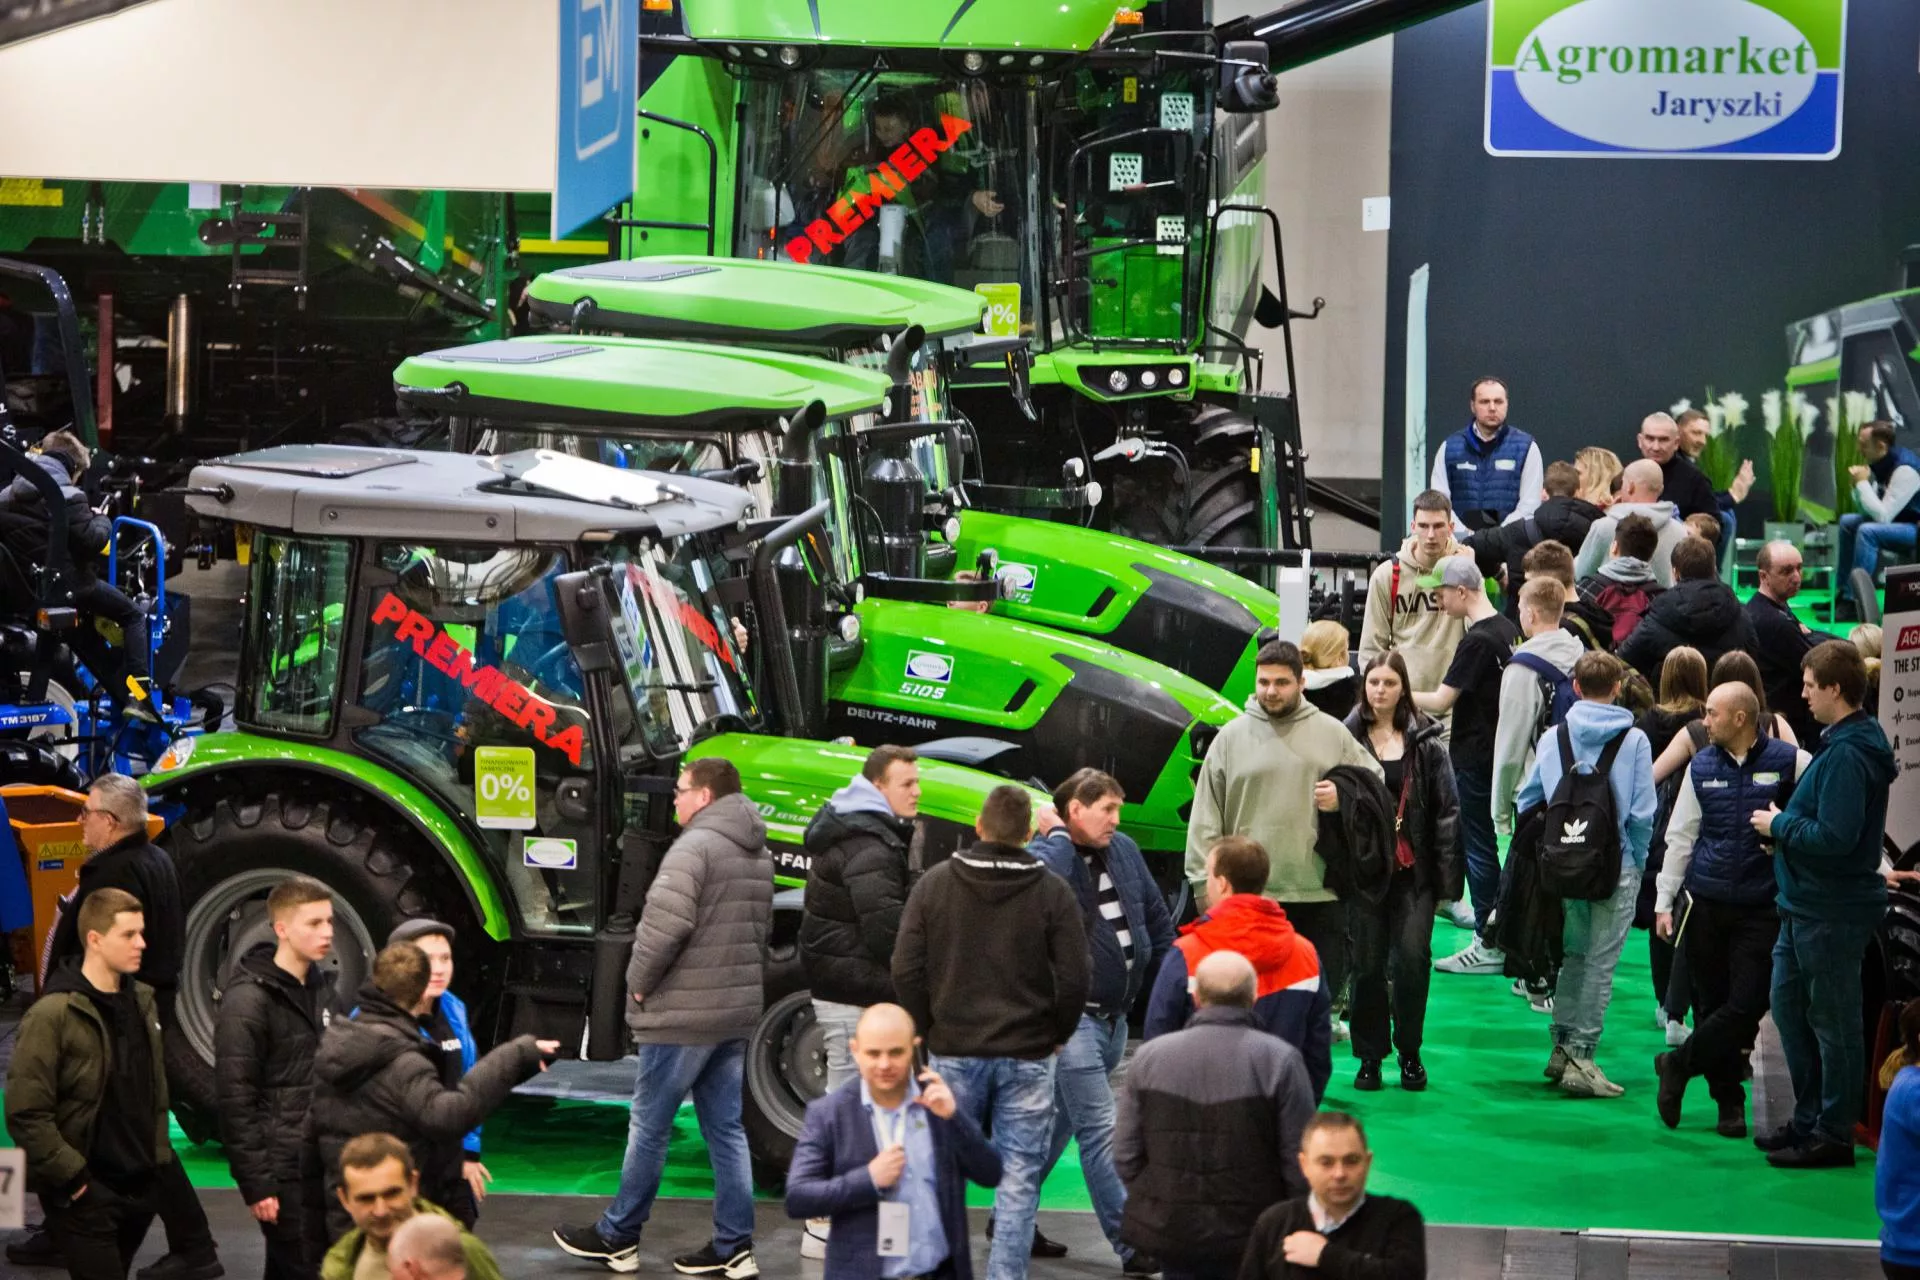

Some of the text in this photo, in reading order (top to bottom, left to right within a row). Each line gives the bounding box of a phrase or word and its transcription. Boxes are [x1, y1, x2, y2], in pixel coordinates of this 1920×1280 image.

[1517, 36, 1813, 84] Agromarket
[1652, 91, 1782, 123] Jaryszki
[784, 112, 972, 264] PREMIERA
[371, 591, 583, 768] PREMIERA
[847, 706, 937, 730] DEUTZ-FAHR
[481, 773, 530, 802] 0%
[1560, 835, 1586, 844] adidas
